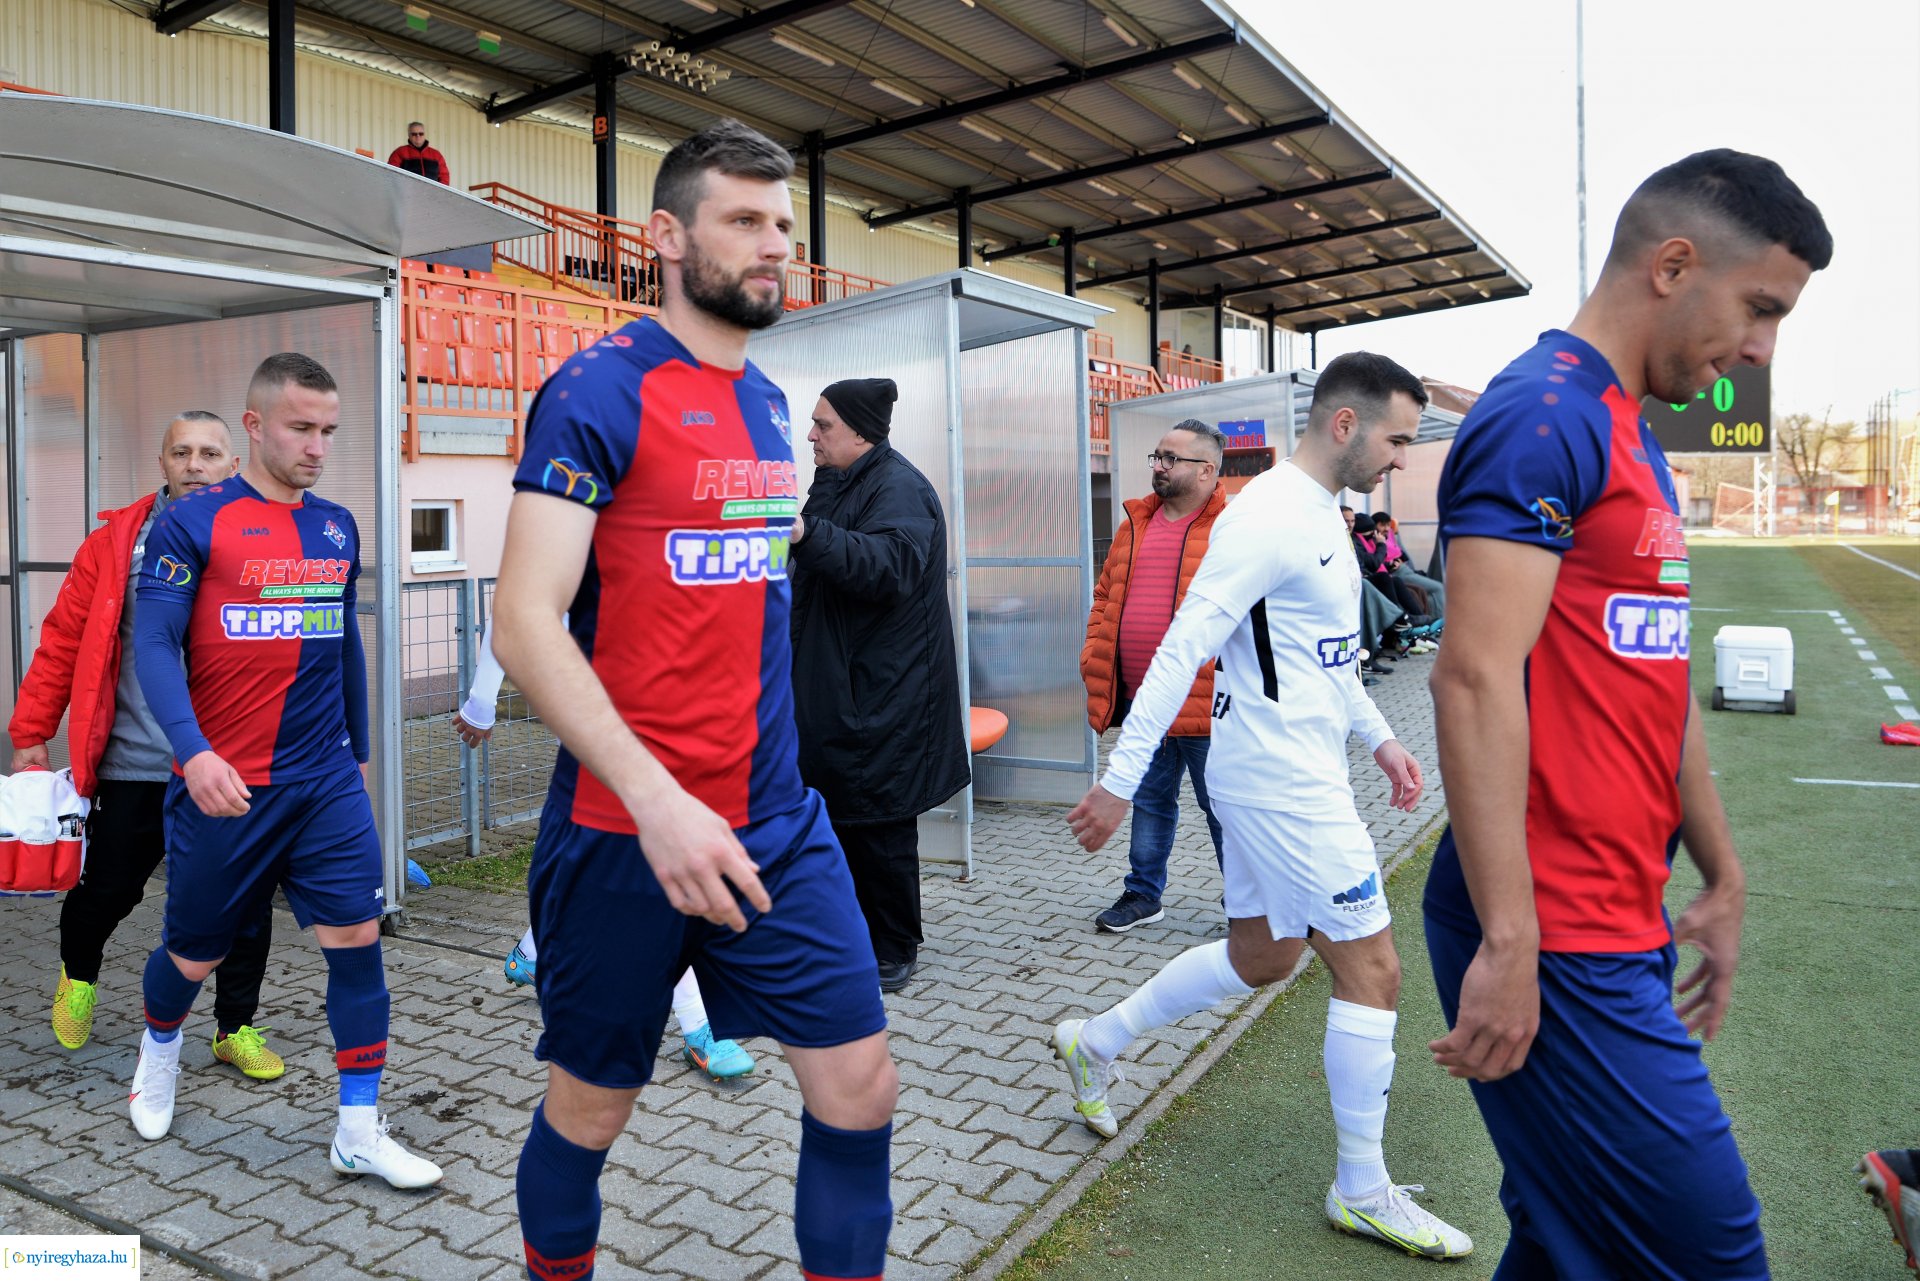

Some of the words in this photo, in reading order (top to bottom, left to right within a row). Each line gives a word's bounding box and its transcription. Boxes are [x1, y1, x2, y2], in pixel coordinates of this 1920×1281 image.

[595, 116, 608, 135] B
[681, 410, 715, 426] JAKO
[1224, 432, 1265, 448] ENDÉG
[1711, 422, 1763, 447] 0:00
[693, 459, 797, 500] REVES
[239, 559, 350, 585] REVESZ
[263, 588, 292, 596] ALWAYS
[292, 587, 302, 595] ON
[317, 586, 334, 594] RIGHT
